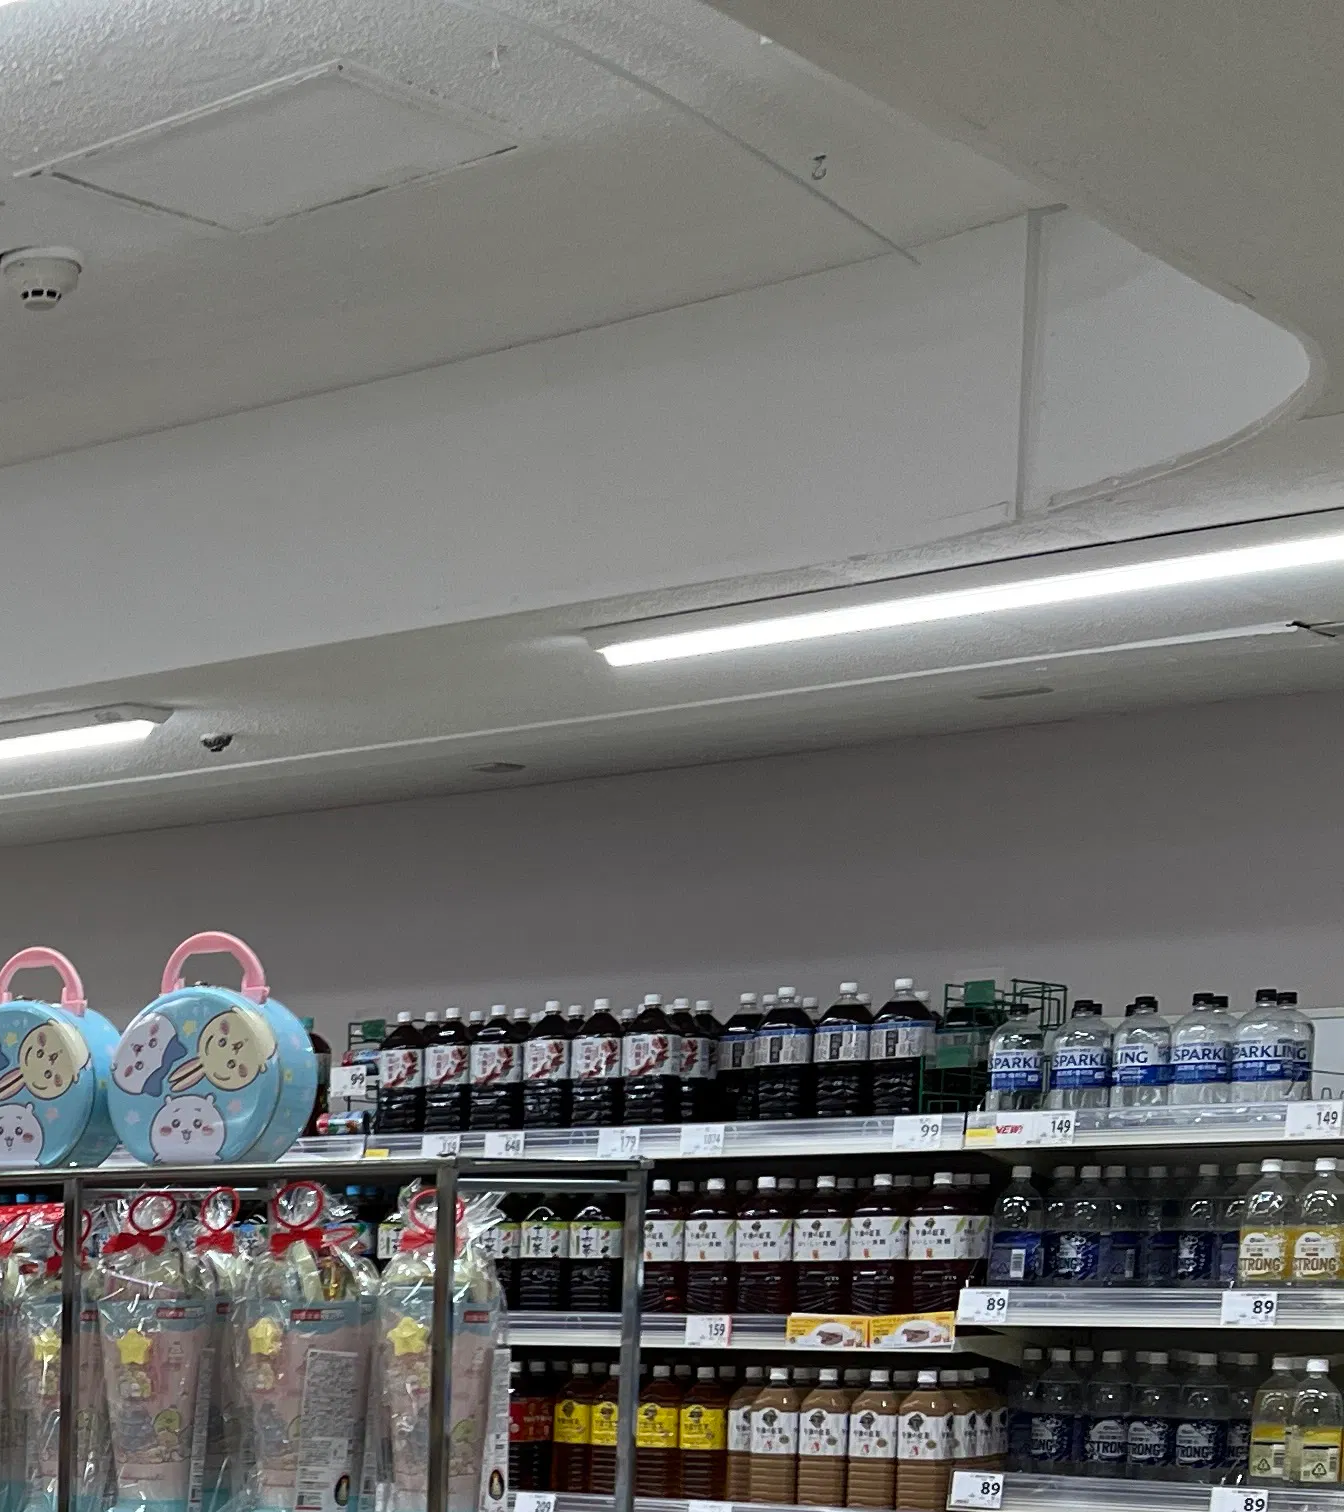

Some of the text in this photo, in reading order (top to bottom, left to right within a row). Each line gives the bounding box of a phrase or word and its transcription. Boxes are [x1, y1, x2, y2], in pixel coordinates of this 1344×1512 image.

[1316, 1111, 1338, 1125] 149
[920, 1124, 939, 1138] 99
[1051, 1119, 1071, 1133] 149
[987, 1298, 1006, 1311] 89
[1252, 1301, 1274, 1315] 89
[708, 1323, 725, 1336] 159
[980, 1482, 1000, 1496] 89
[1243, 1497, 1265, 1512] 89
